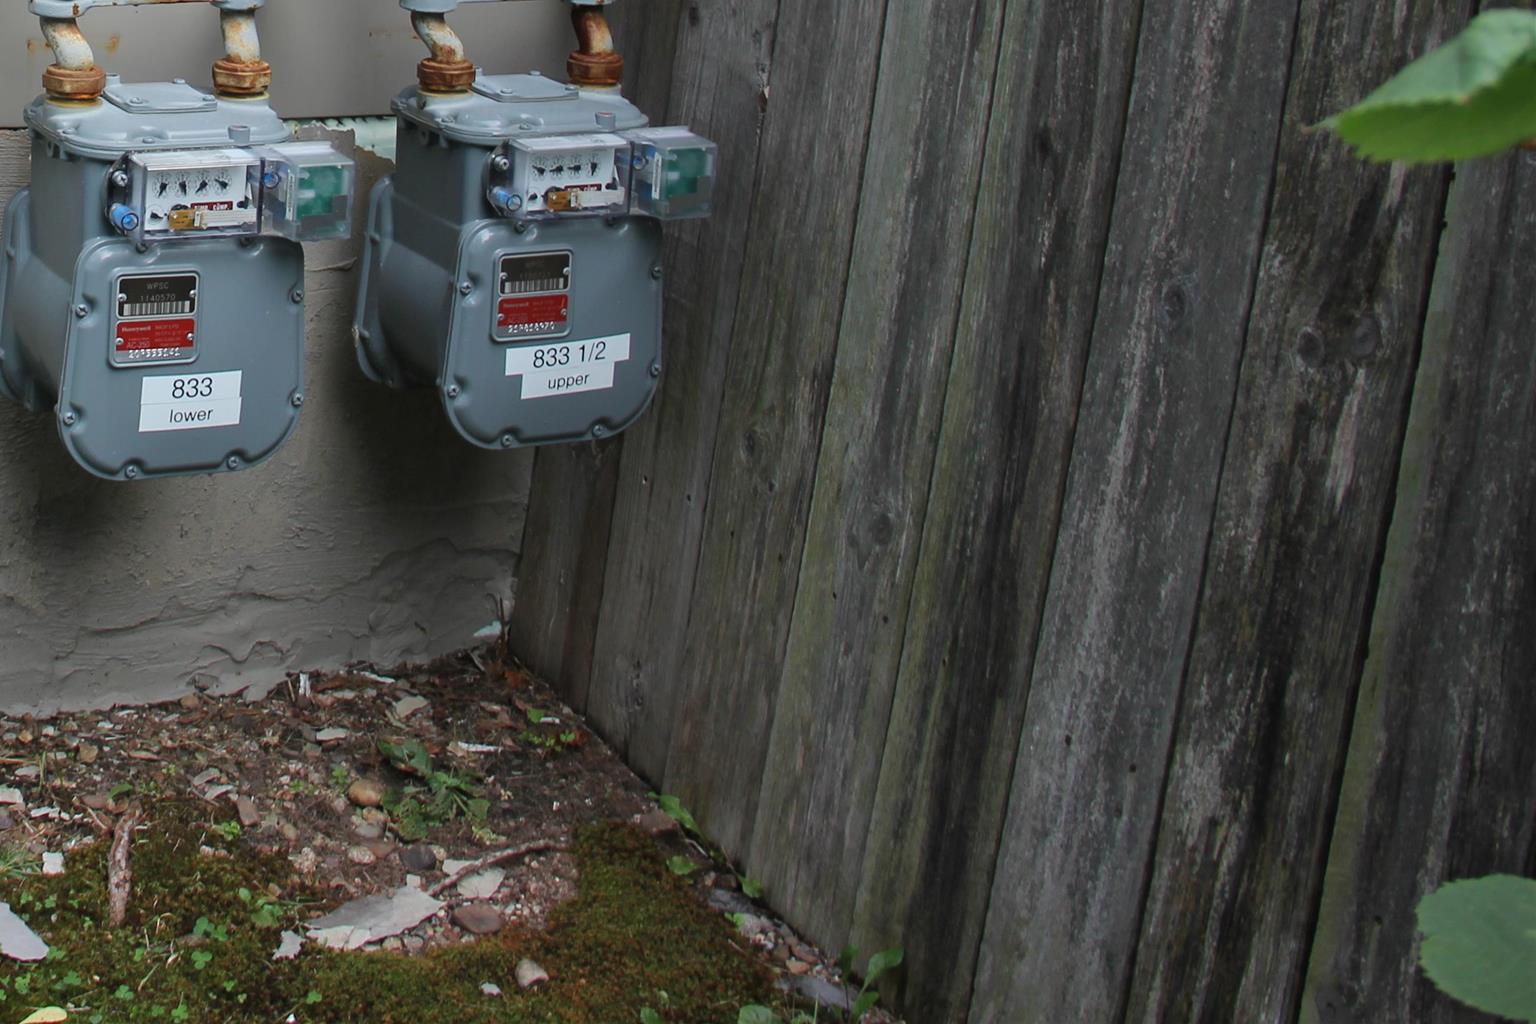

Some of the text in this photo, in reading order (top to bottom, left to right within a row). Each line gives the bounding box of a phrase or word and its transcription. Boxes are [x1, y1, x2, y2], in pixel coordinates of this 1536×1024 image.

[533, 341, 606, 368] 833 1/2
[172, 377, 213, 399] 833
[548, 373, 590, 391] upper
[169, 409, 214, 423] lower
